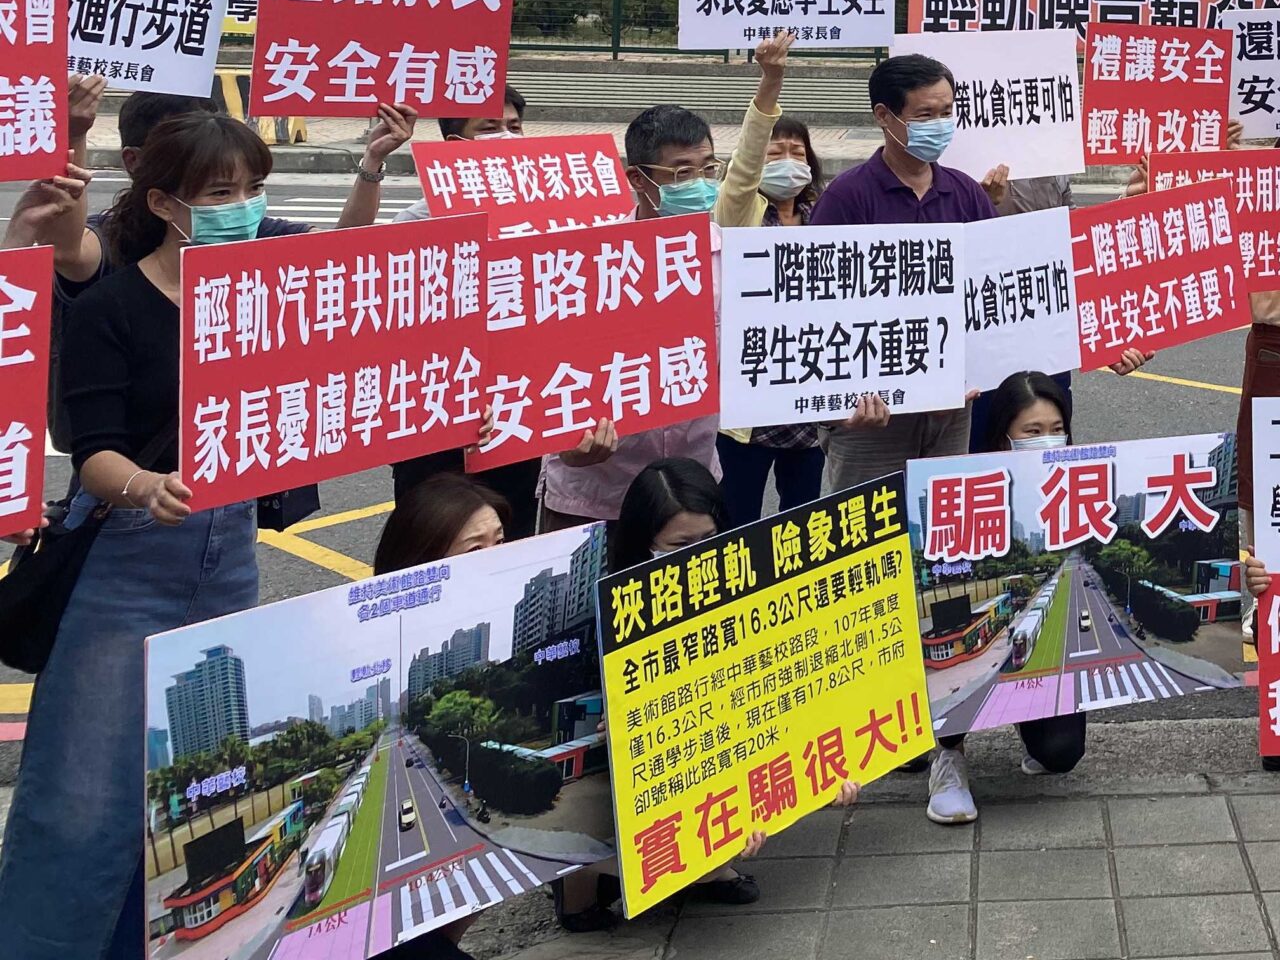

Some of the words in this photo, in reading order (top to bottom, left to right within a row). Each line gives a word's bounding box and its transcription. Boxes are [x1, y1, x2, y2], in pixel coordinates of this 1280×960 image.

[262, 39, 496, 104] 安全有感
[1090, 33, 1226, 84] 禮讓安全
[1086, 107, 1223, 155] 輕軌改道
[425, 150, 622, 209] 中華藝校家長會
[740, 238, 955, 303] 二階輕軌穿腸過
[1070, 196, 1234, 278] 二階輕軌穿腸過
[193, 240, 481, 365] 輕軌汽車共用路權
[486, 230, 702, 332] 還路於民
[964, 259, 1070, 333] 比貪污更可怕
[1078, 264, 1237, 353] 學生安全不重要？
[740, 315, 949, 388] 學生安全不重要？
[193, 346, 482, 483] 家長憂慮學生安全
[478, 335, 709, 455] 安全有感
[925, 448, 1220, 562] 騙很大
[611, 537, 757, 644] 狹路輕軌
[771, 485, 901, 579] 險象環生
